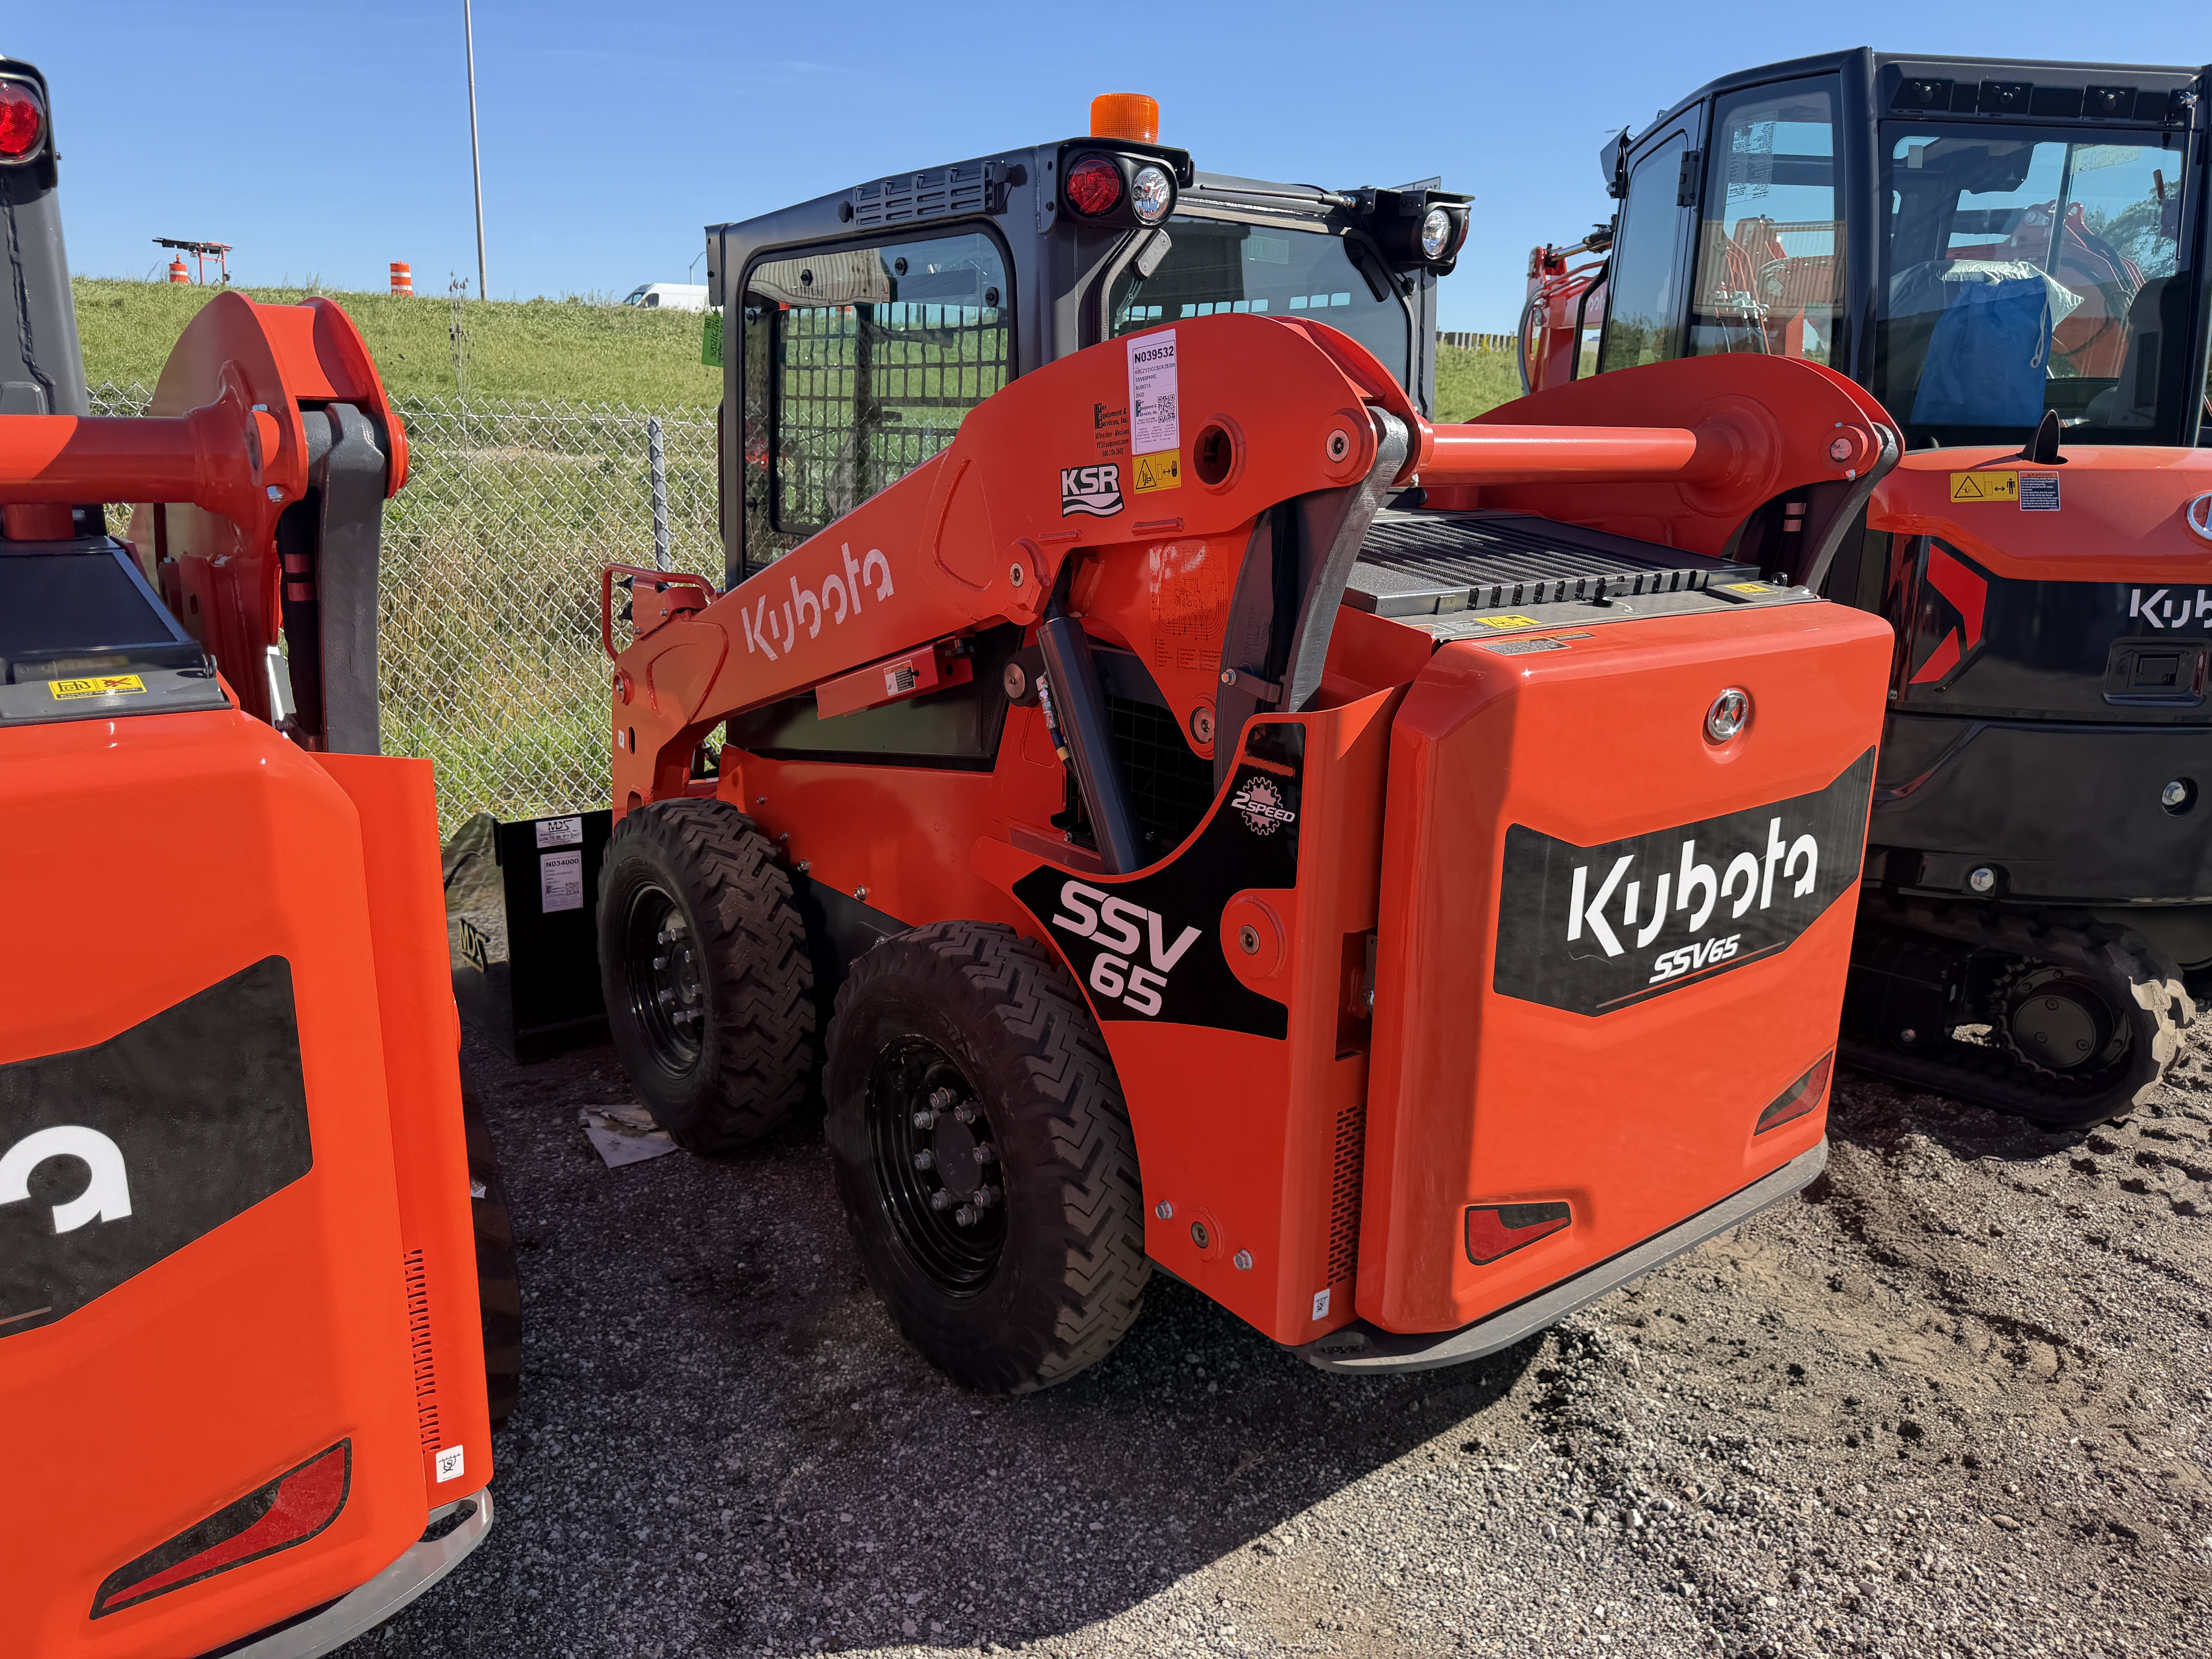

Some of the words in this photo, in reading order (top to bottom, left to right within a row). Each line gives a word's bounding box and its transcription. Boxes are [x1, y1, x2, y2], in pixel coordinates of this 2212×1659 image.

[1134, 345, 1174, 363] N039532
[1099, 409, 1122, 420] Equipment
[1061, 465, 1119, 496] KSR
[741, 542, 894, 661] Kubota
[548, 819, 573, 833] MDS
[546, 858, 579, 867] N034000
[1567, 817, 1818, 957] Kubota
[1052, 880, 1202, 973] SSV
[1649, 934, 1741, 984] SSV65
[1089, 953, 1168, 1016] 65
